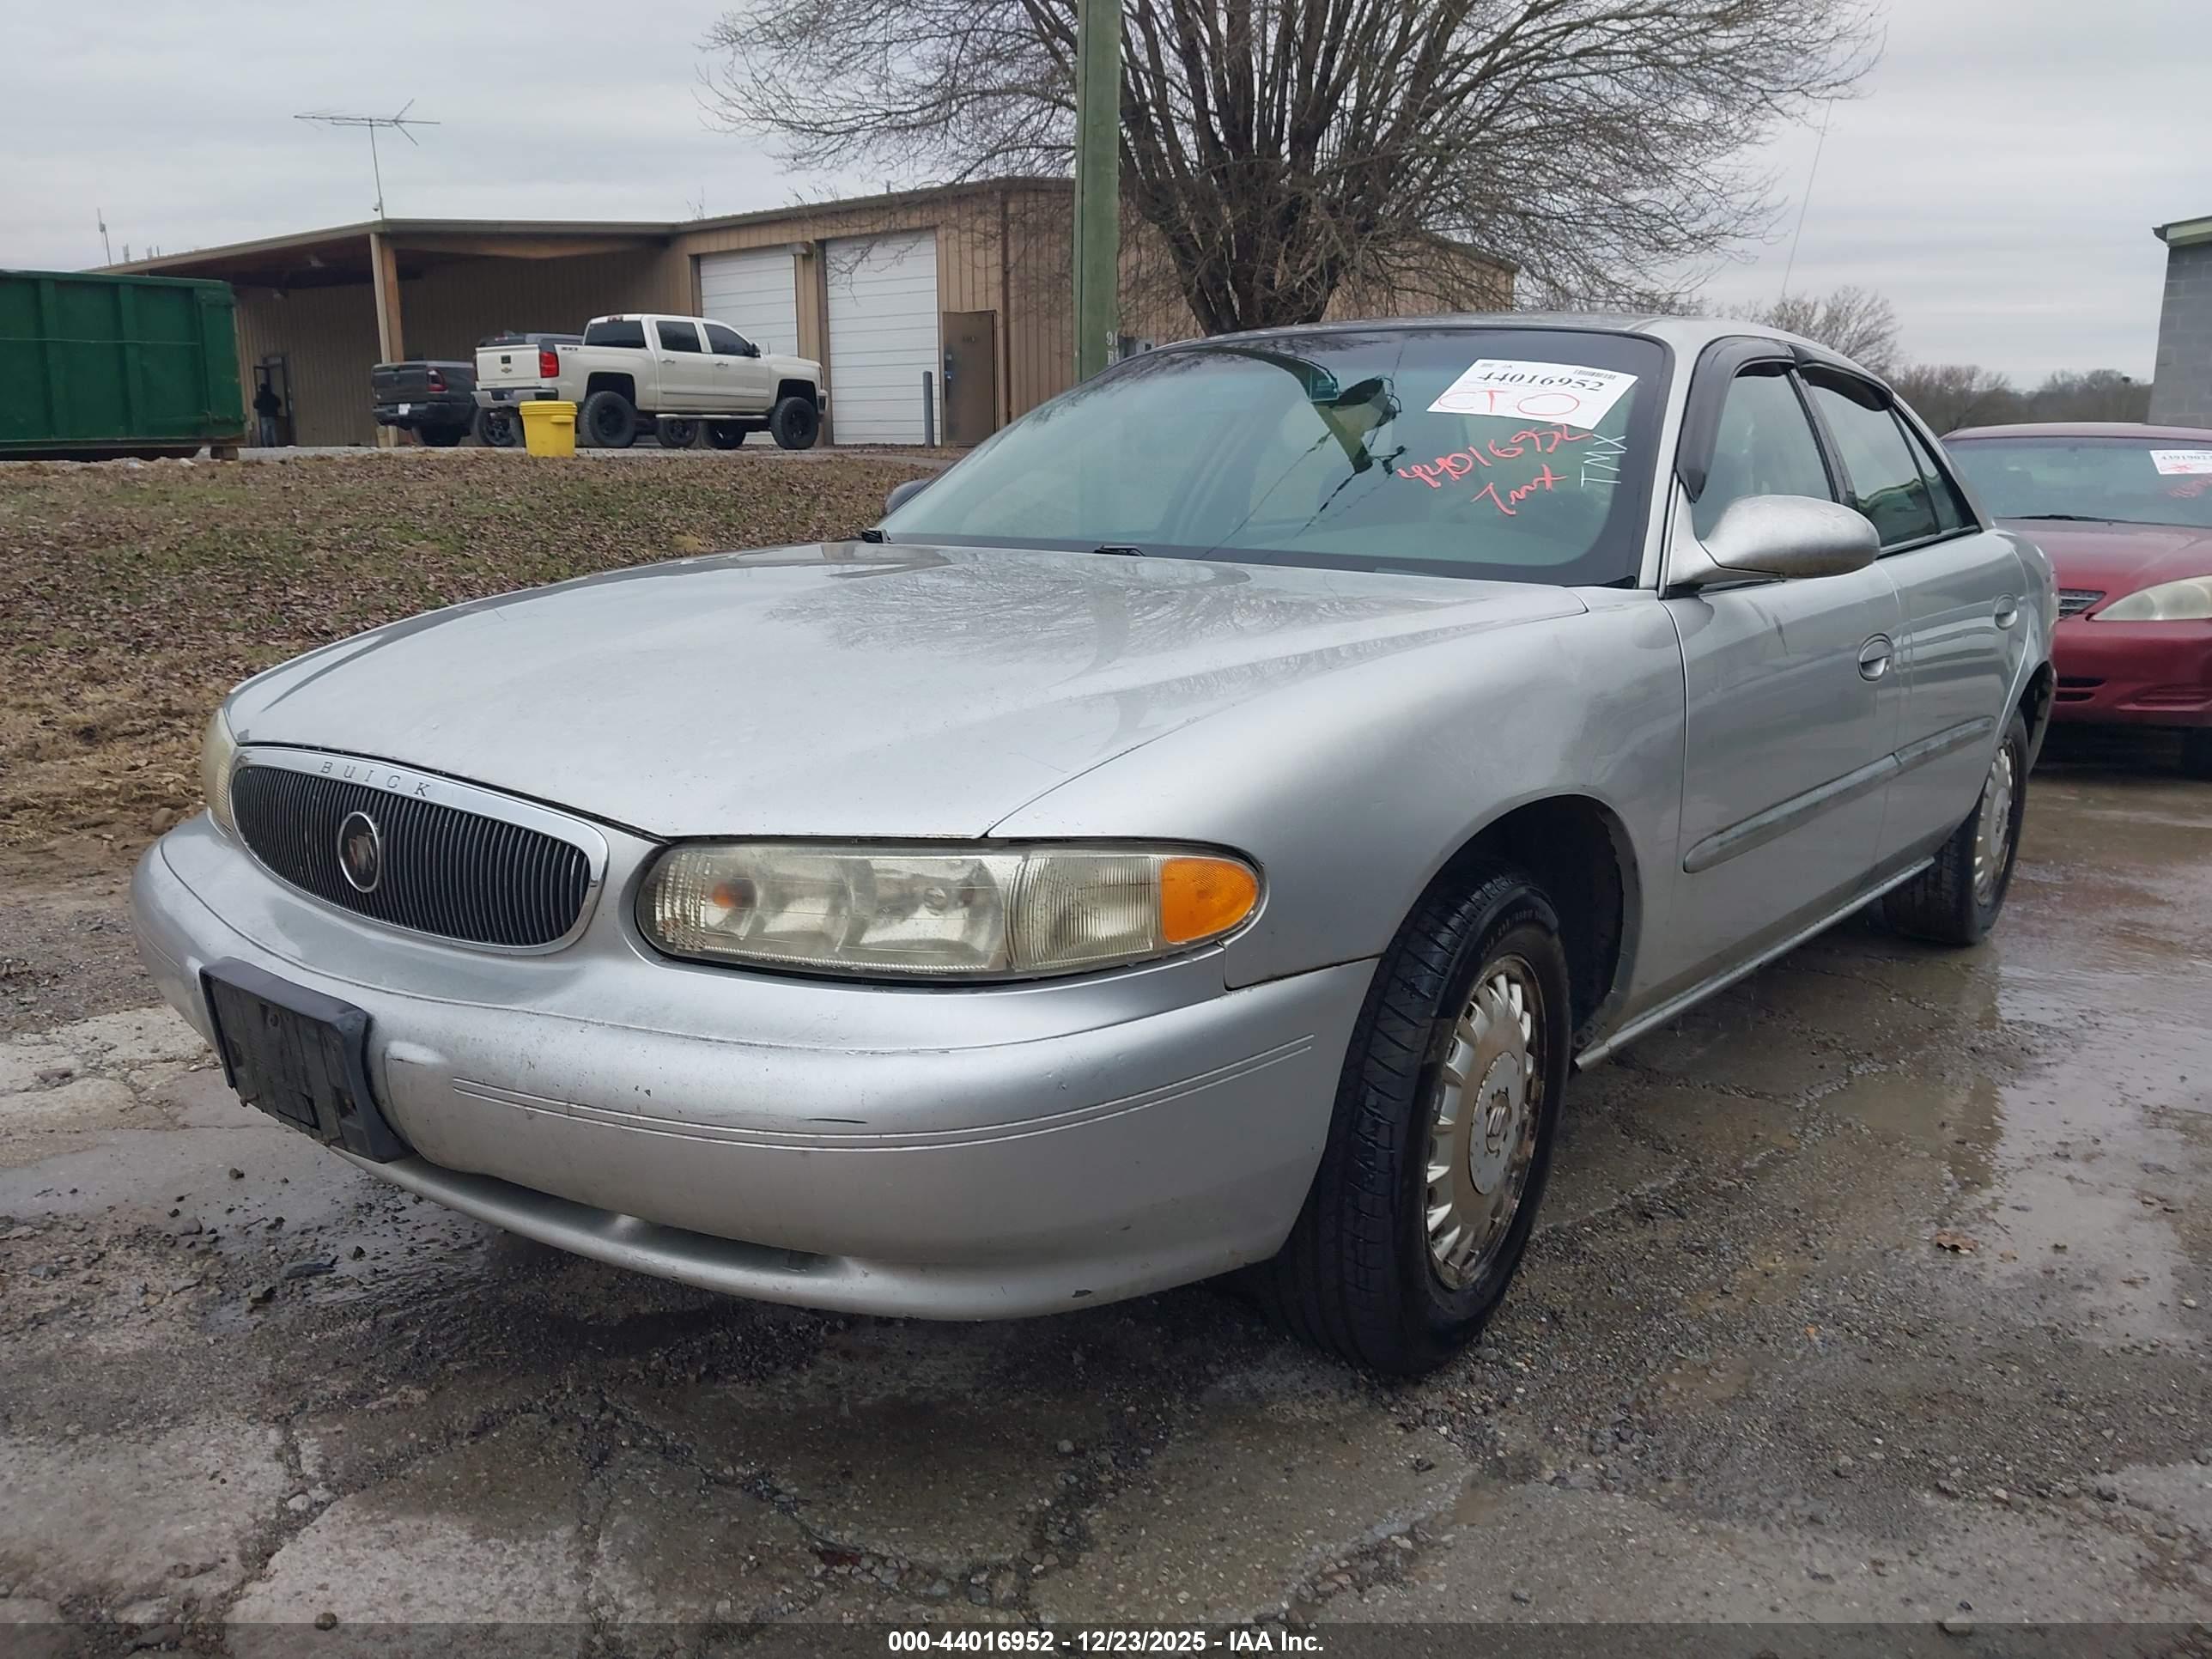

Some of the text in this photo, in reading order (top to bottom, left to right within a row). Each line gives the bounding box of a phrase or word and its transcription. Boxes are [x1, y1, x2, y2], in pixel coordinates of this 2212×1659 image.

[1477, 371, 1606, 392] 44016952
[1580, 433, 1629, 489] TMX
[320, 761, 430, 798] BUICK
